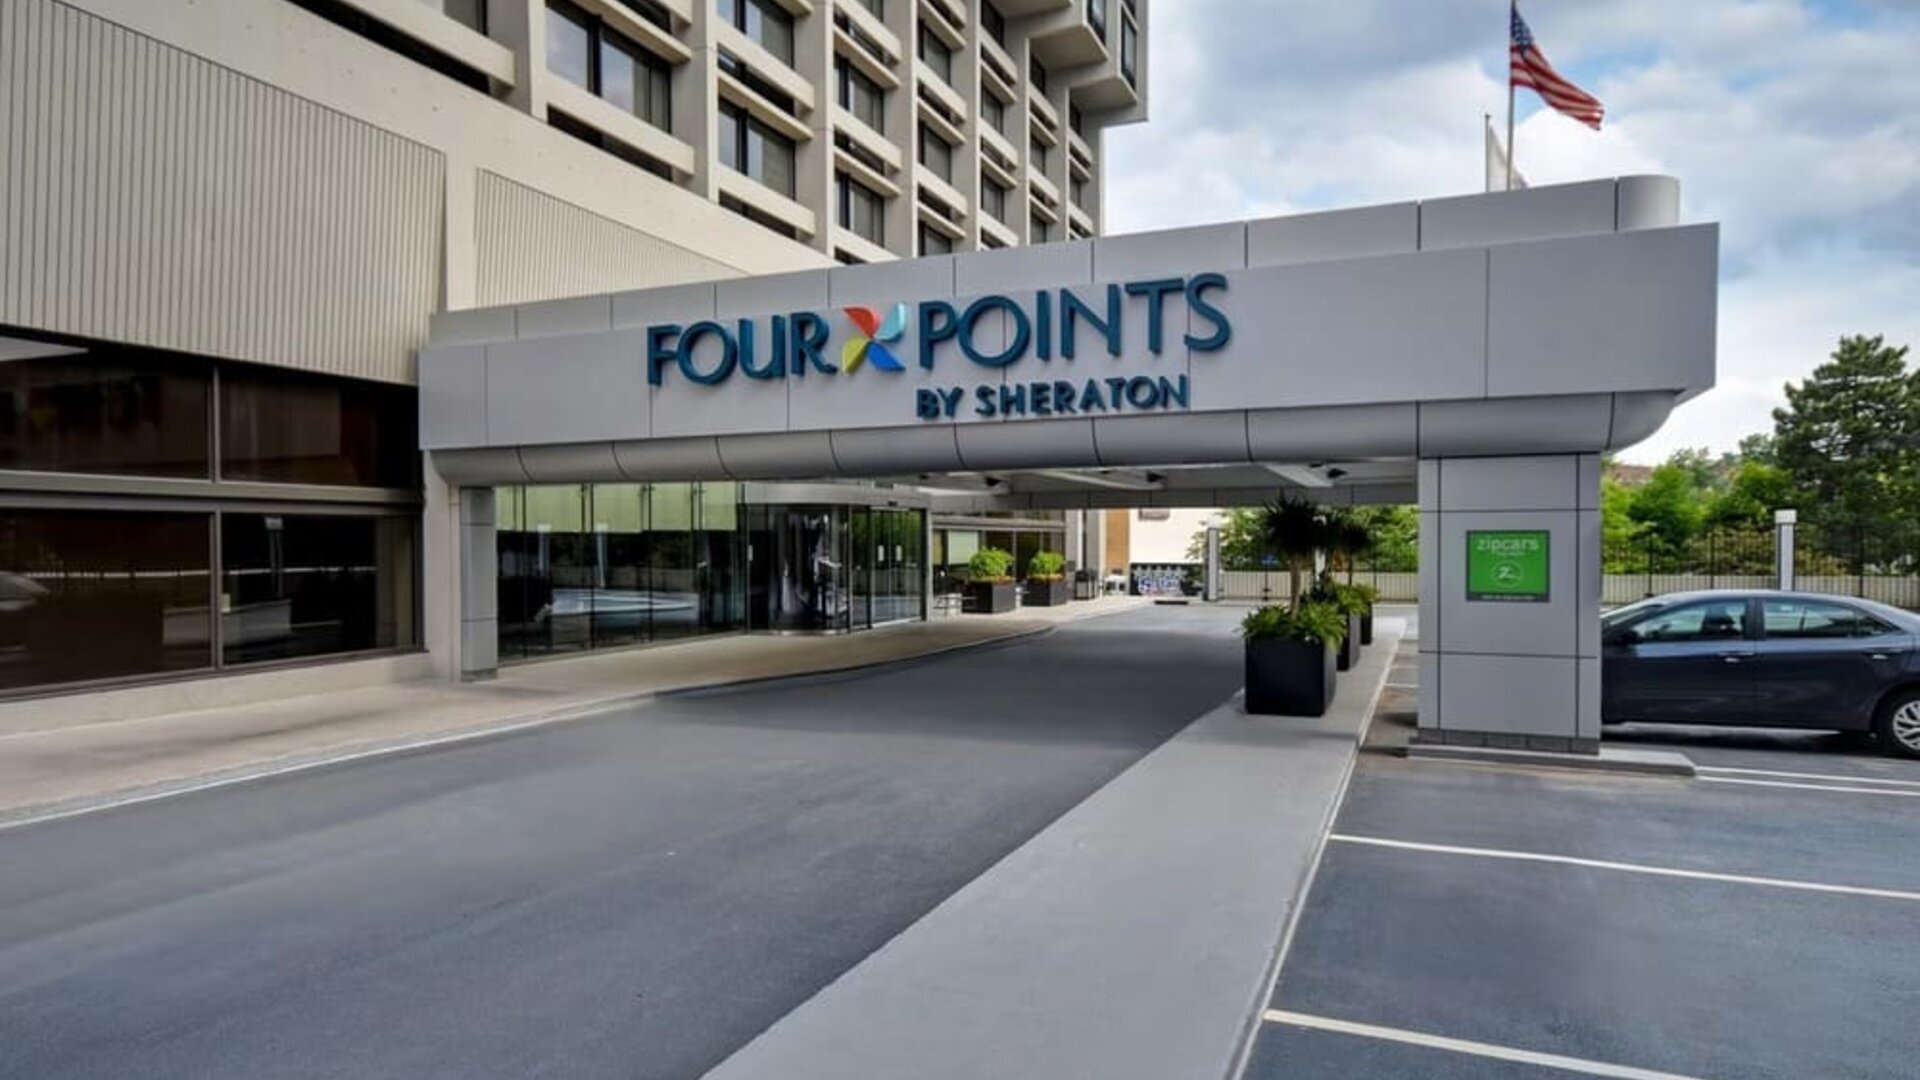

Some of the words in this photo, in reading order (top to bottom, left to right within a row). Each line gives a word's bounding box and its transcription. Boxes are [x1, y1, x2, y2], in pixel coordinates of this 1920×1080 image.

[647, 311, 837, 386] FOUR
[918, 272, 1231, 371] POINTS
[916, 386, 965, 420] BY
[975, 374, 1190, 416] SHERATON
[1476, 538, 1540, 555] zipcars
